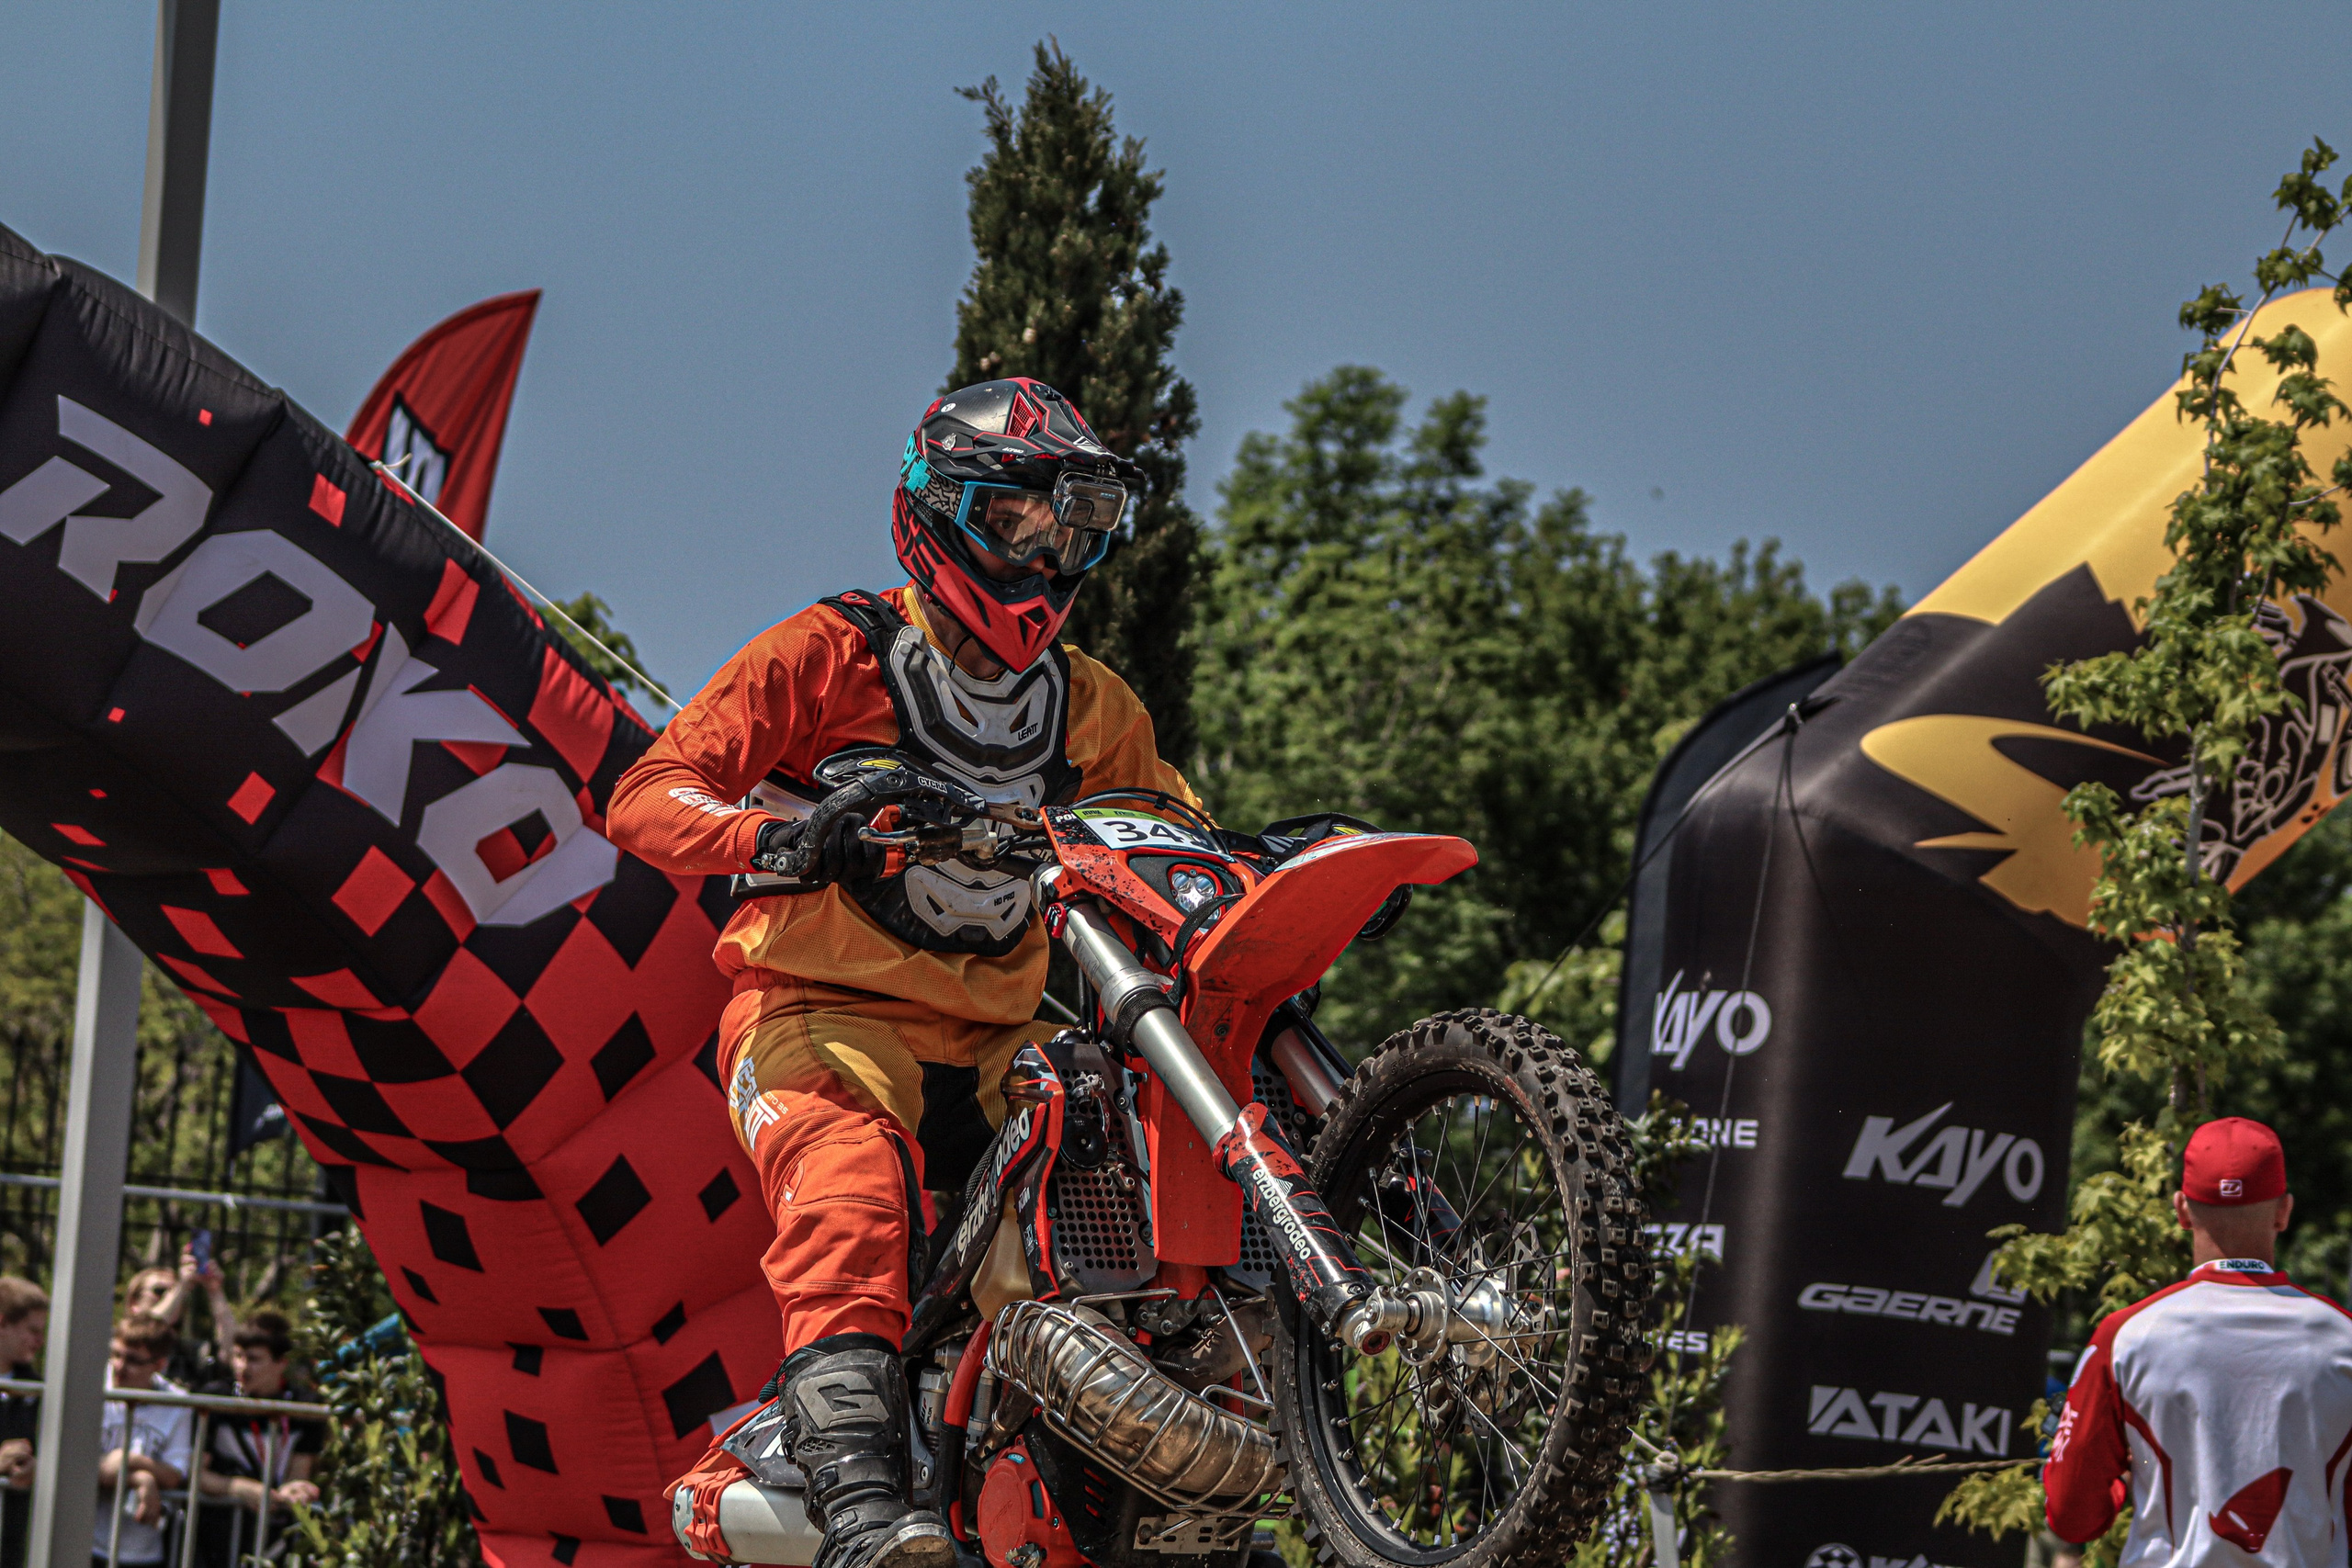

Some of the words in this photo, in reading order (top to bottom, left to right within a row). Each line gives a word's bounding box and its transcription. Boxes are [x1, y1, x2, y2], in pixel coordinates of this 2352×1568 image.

[918, 776, 947, 793] CYCRA
[1003, 891, 1015, 902] PRO
[1841, 1100, 2044, 1207] KAYO
[1252, 1167, 1311, 1261] erzbergrodeo
[2219, 1259, 2265, 1269] ENDURO
